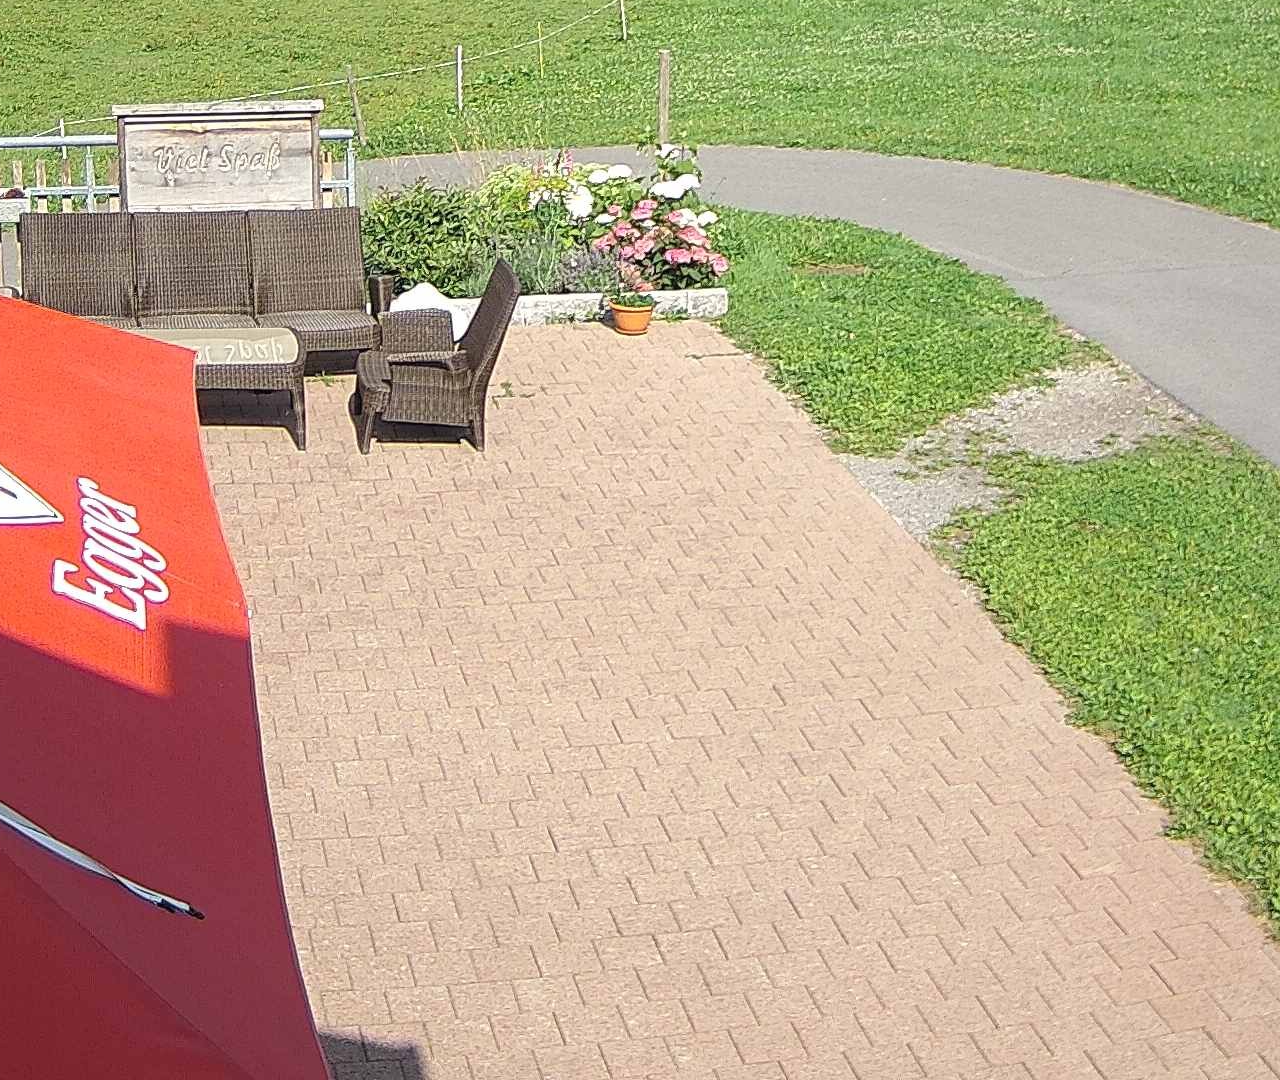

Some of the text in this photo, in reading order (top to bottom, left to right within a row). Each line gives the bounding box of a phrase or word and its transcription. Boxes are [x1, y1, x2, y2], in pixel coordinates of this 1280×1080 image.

[153, 141, 281, 178] Viel Spaß
[51, 476, 170, 631] Egger
